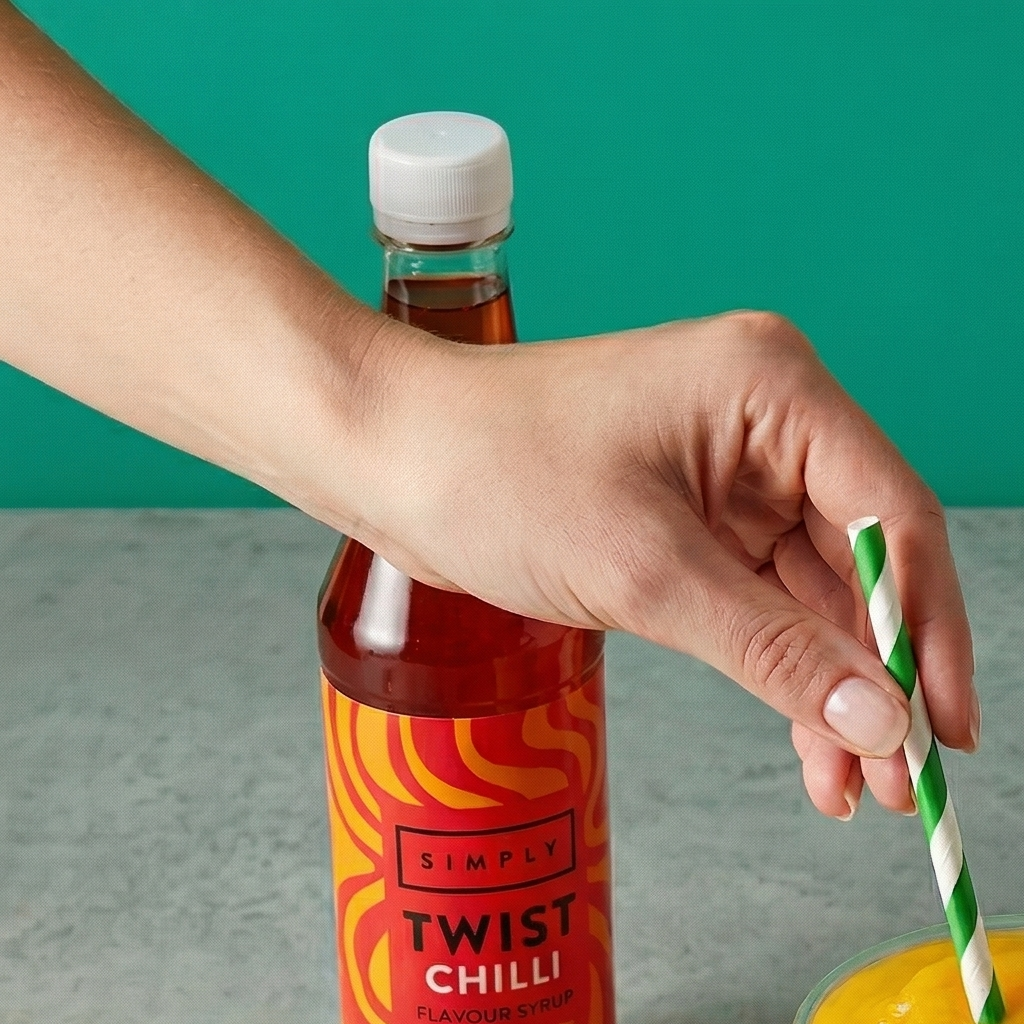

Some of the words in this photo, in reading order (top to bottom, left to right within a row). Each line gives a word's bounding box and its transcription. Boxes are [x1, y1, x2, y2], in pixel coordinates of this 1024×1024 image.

[421, 839, 557, 871] SIMPLY
[402, 893, 576, 956] TWIST
[425, 950, 561, 995] CHILLI
[417, 1006, 511, 1024] FLAVOUR
[517, 989, 574, 1017] SYRUP
